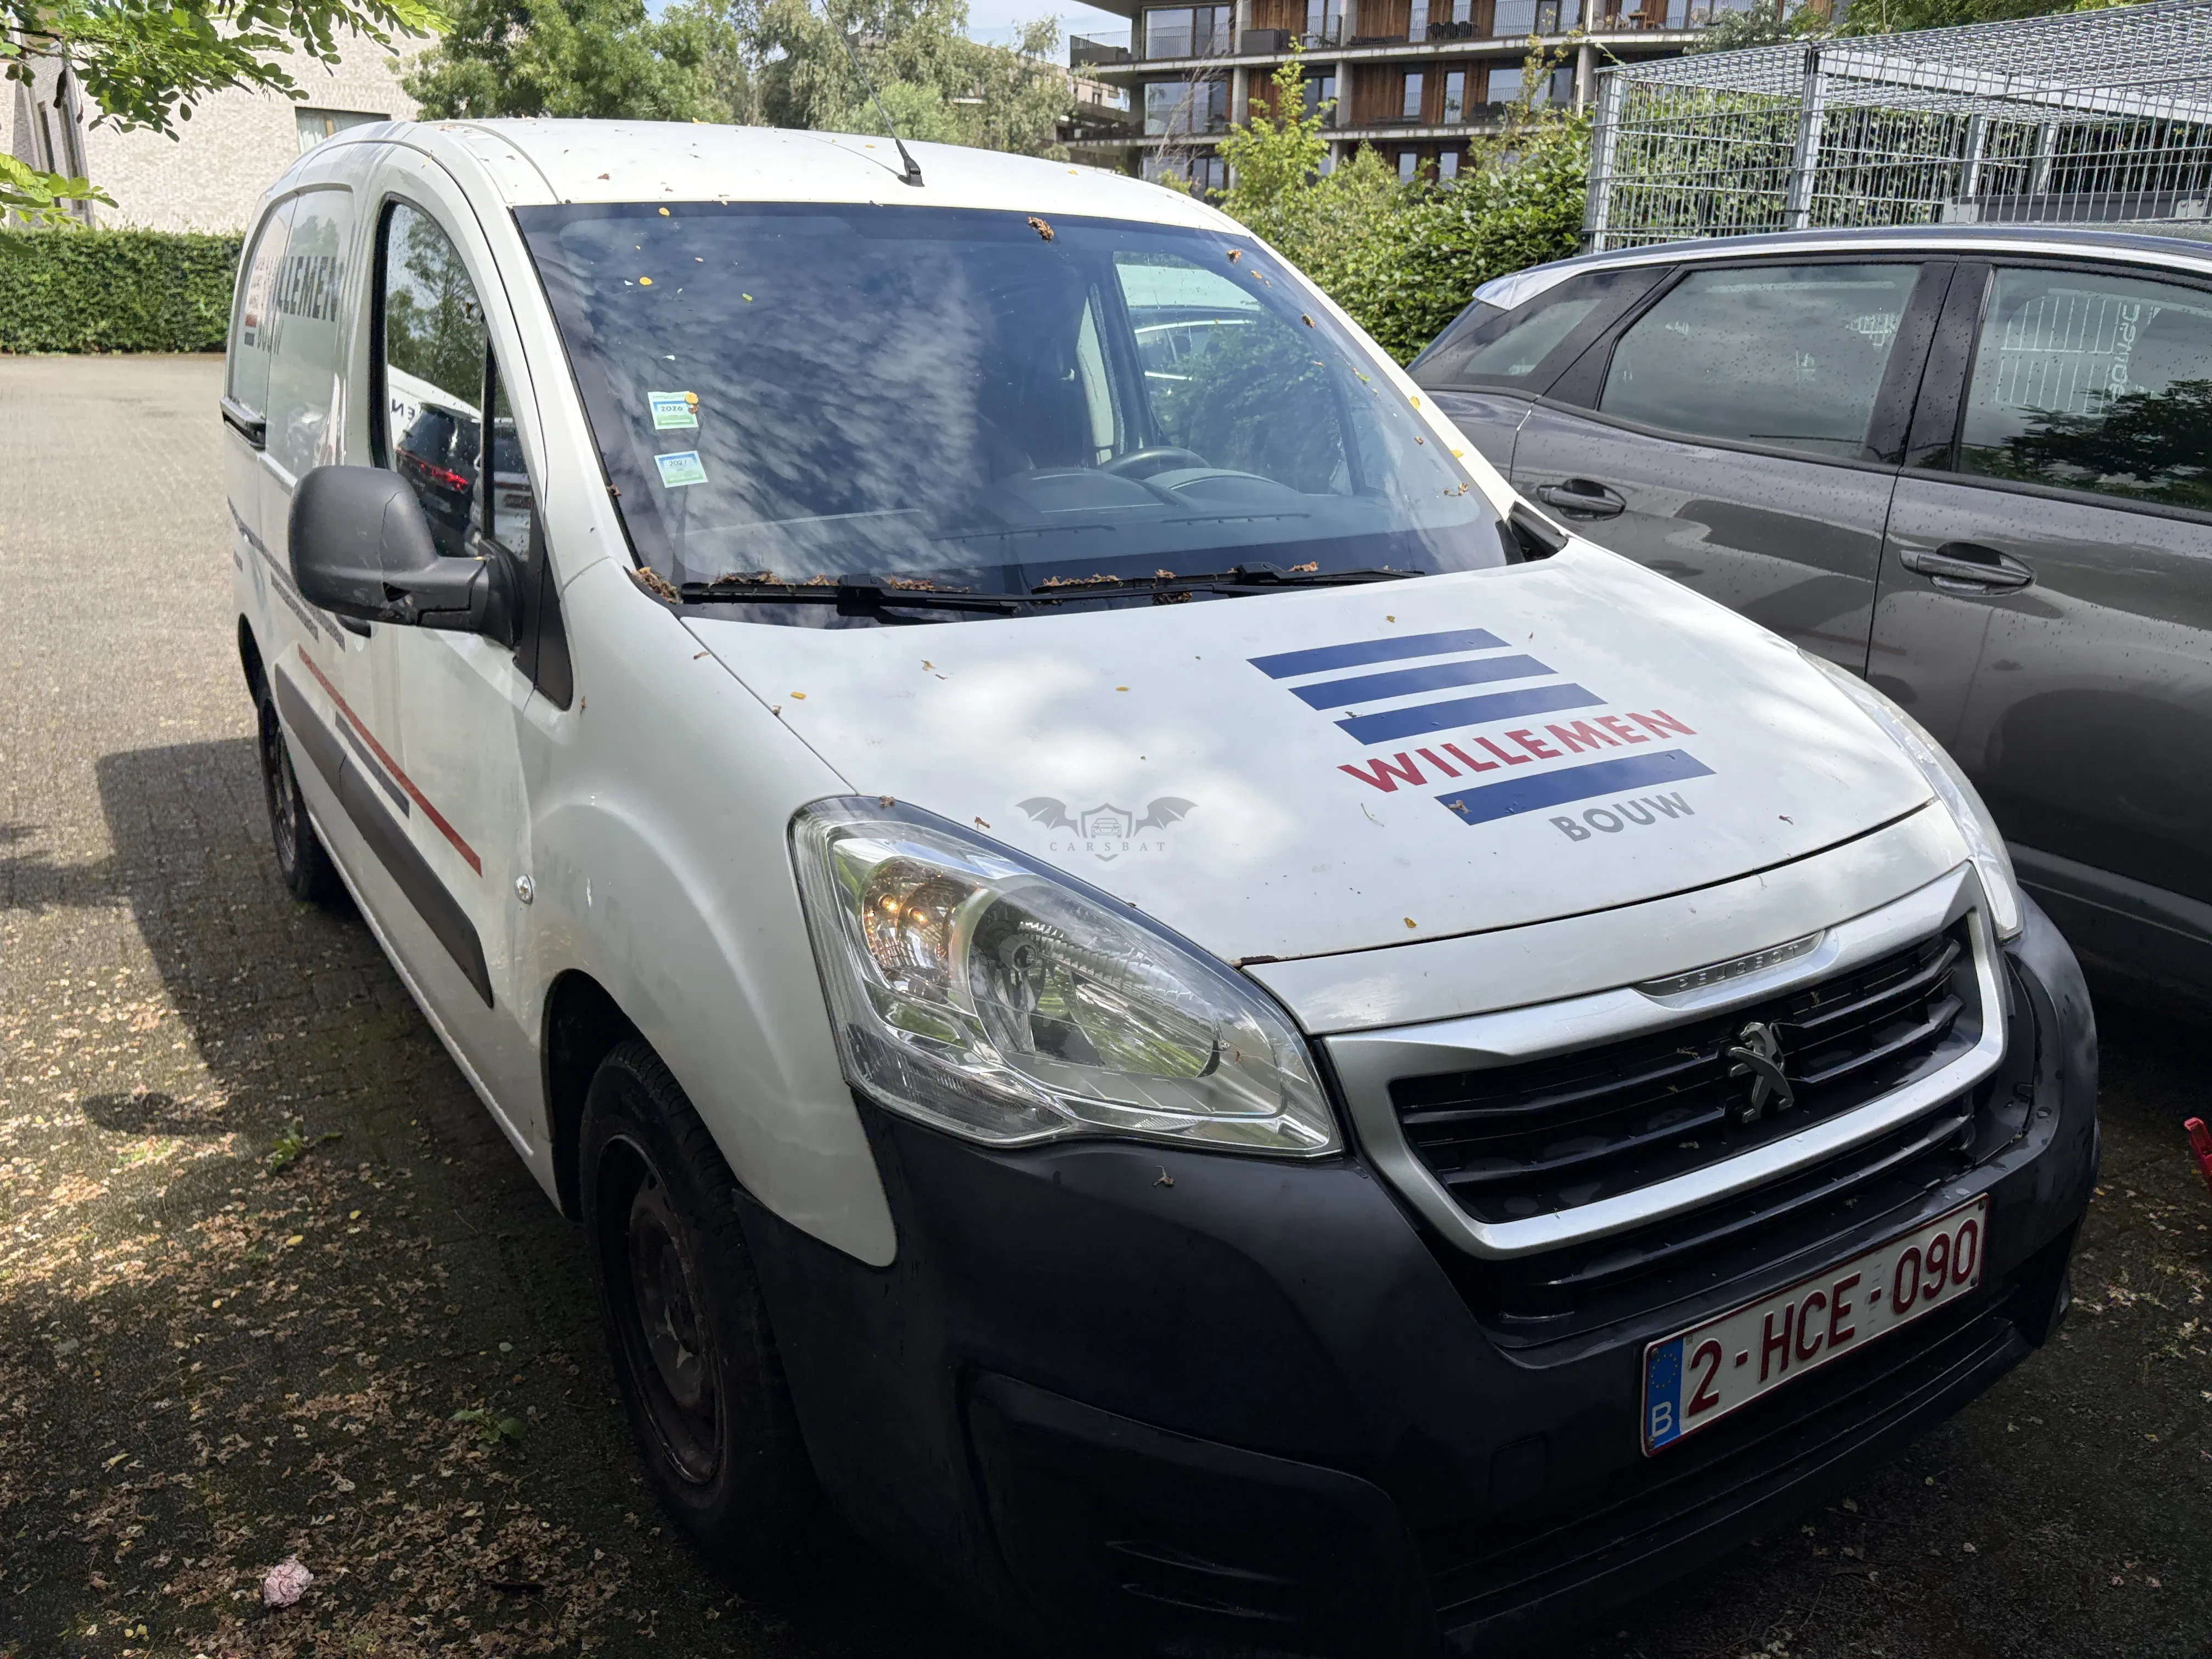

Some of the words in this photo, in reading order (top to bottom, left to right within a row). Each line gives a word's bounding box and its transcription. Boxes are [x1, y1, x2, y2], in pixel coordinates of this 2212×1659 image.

[1336, 709, 1698, 793] WILLEMEN
[1549, 792, 1695, 842] BOUW
[1676, 945, 1799, 992] PEUGEOT
[1686, 1217, 1979, 1418] 2-HCE-090
[1651, 1401, 1673, 1437] B
